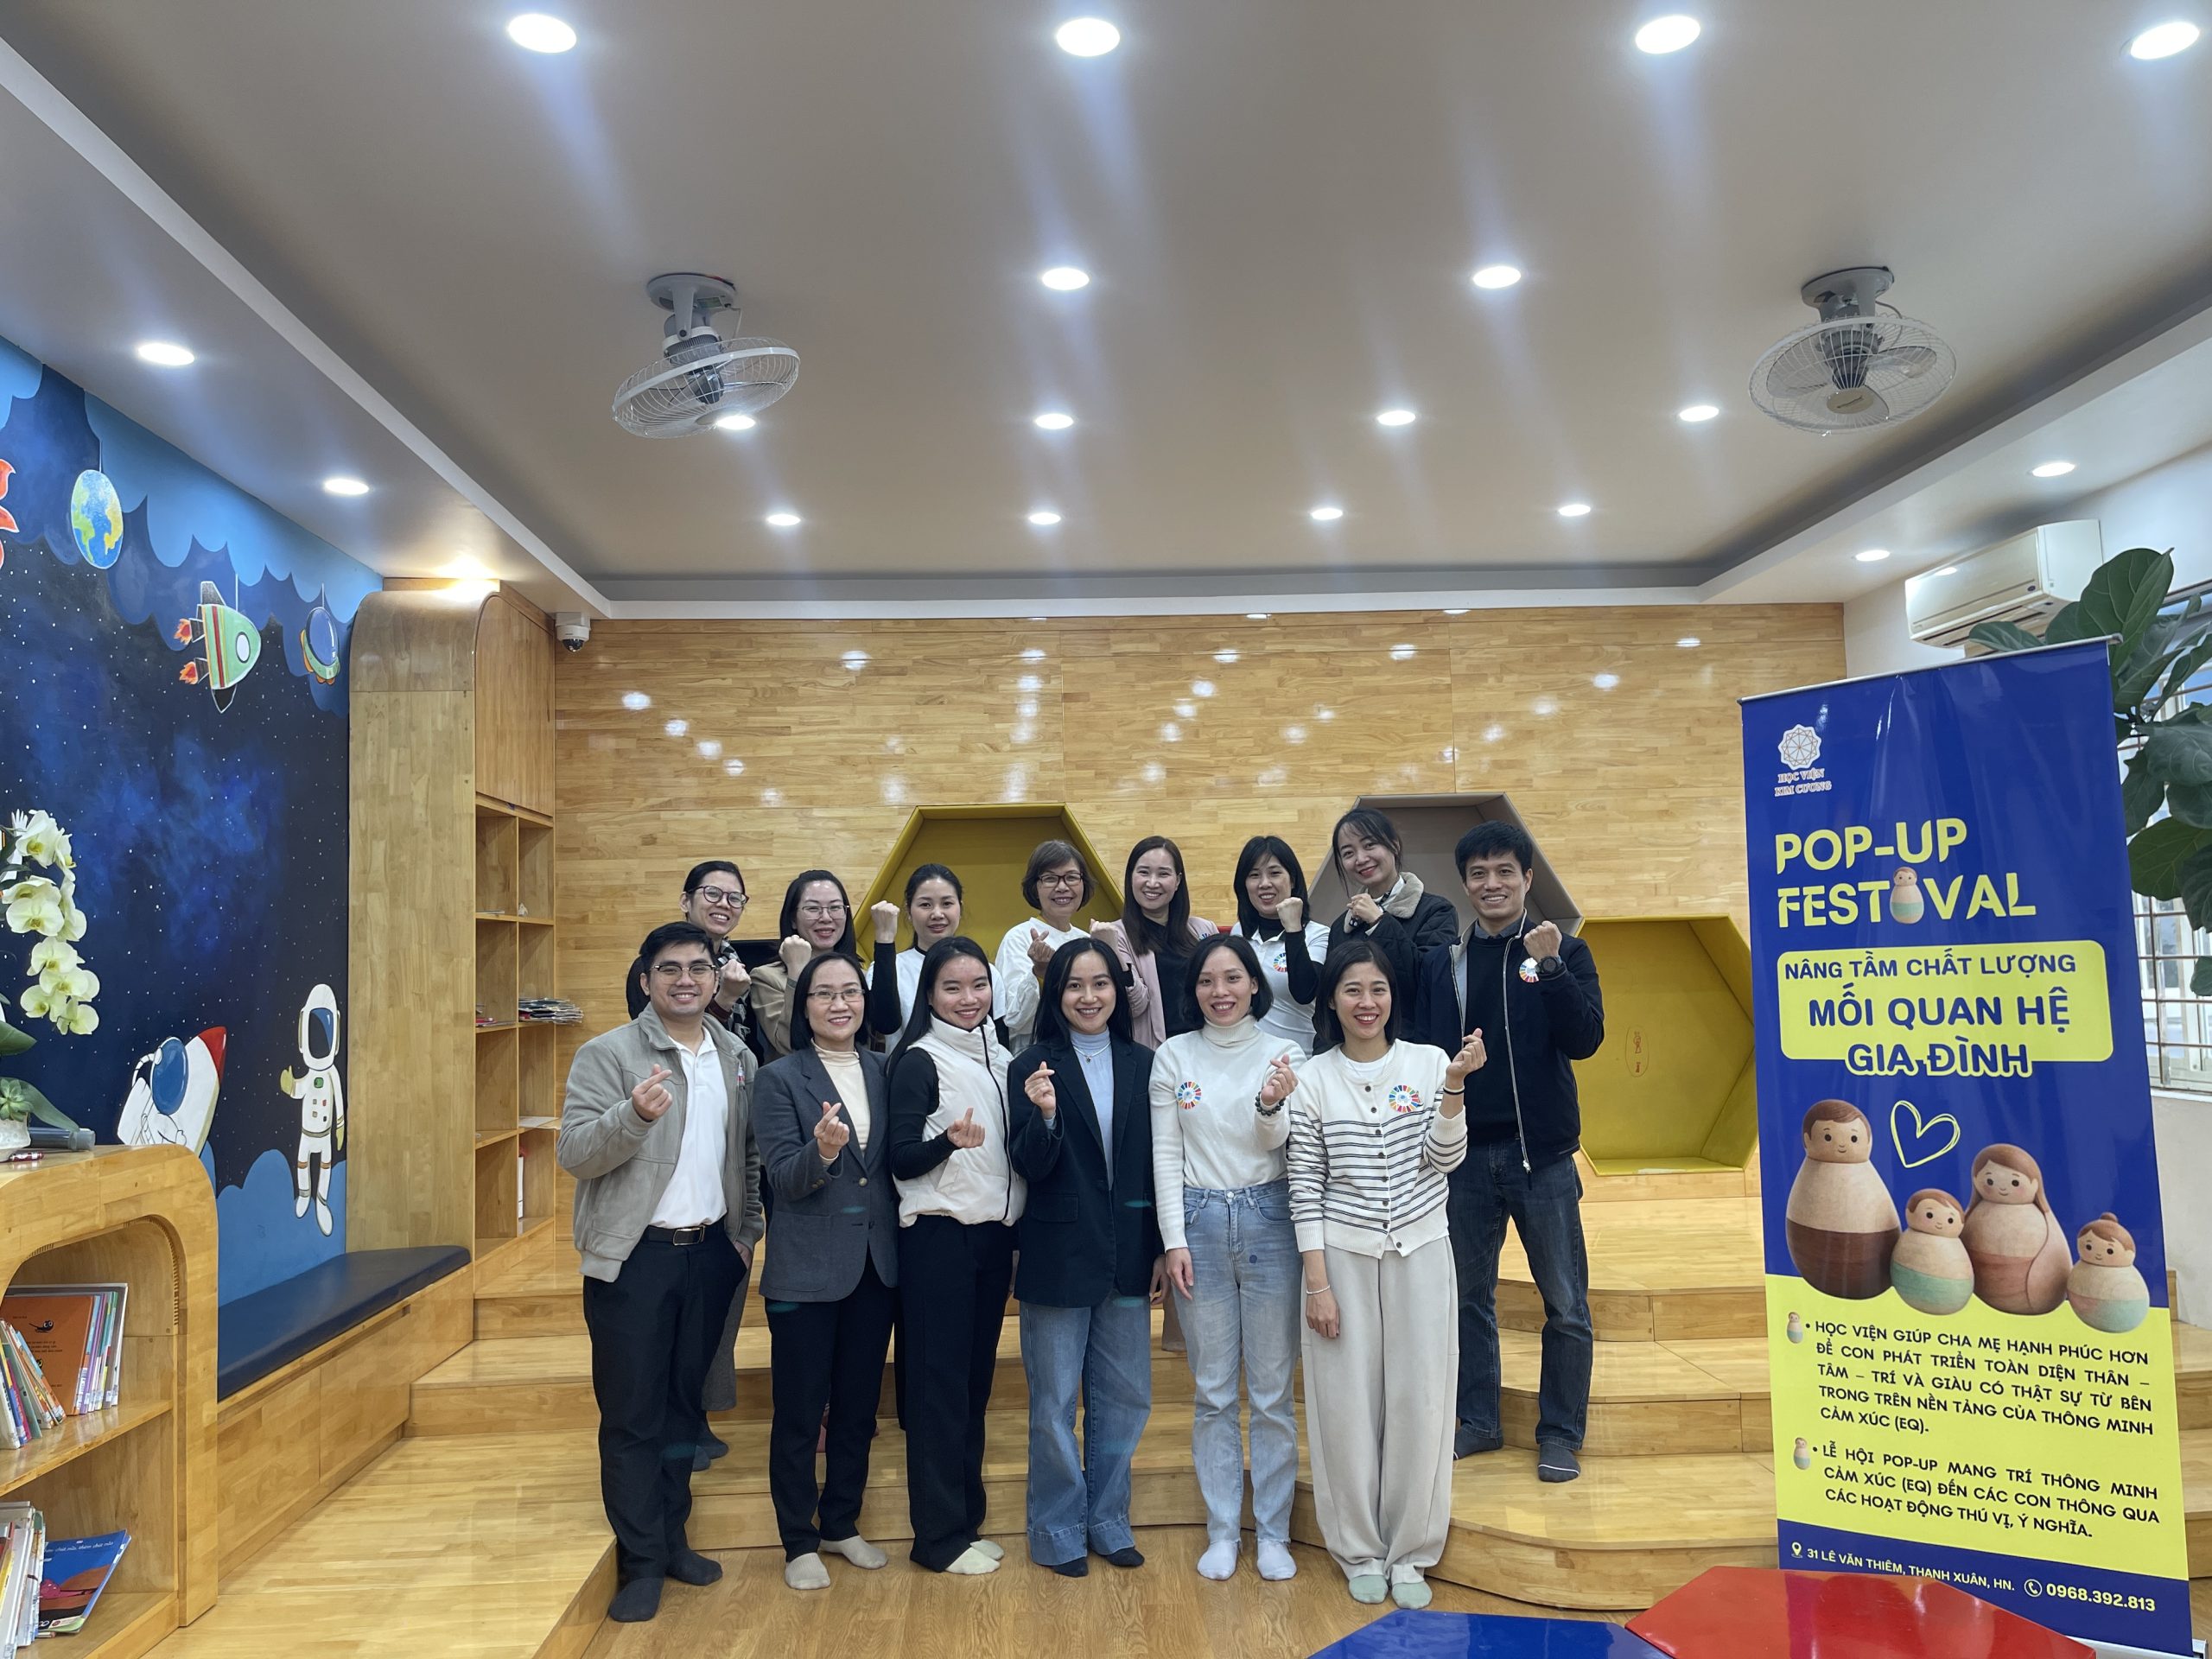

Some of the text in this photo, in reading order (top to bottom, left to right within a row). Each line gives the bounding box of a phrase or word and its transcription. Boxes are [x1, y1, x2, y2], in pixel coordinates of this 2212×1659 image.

[1776, 818, 1967, 874] POP-UP
[1778, 873, 2036, 927] FESTVAL
[1786, 949, 2075, 979] NÂNG TẦM CHẤT LƯỢNG
[1809, 982, 2069, 1033] MỐI QUAN HỆ
[1848, 1036, 2028, 1073] GIA ĐÌNH
[1816, 1321, 2147, 1364] HỌC VIỆN GIÚP CHA MẸ HẠNH PHÚC HƠN
[1817, 1338, 1832, 1355] ĐỂ
[1841, 1346, 1873, 1359] CON
[1884, 1351, 1921, 1364] PHÁT
[1931, 1351, 1974, 1370] TRIỂN
[1985, 1359, 2028, 1375] TOÀN
[2039, 1364, 2075, 1382] DIỆN
[2085, 1370, 2128, 1386] THÂN
[1818, 1363, 1848, 1378] TÂM
[1872, 1370, 1896, 1383] TRÍ
[1904, 1373, 1923, 1387] VÀ
[1932, 1376, 1971, 1391] GIÀU
[1980, 1381, 2004, 1395] CÓ
[2012, 1385, 2051, 1402] THẬT
[2061, 1391, 2082, 1406] SỰ
[2090, 1392, 2112, 1407] TỪ
[2121, 1395, 2151, 1411] BÊN
[1819, 1386, 2152, 1434] TRONG TRÊN NỀN TẢNG CỦA THÔNG MINH
[1821, 1408, 1929, 1433] CẢM XÚC (EQ).
[1823, 1441, 2157, 1499] LỄ HỘI POP-UP MANG TRÍ THÔNG MINH
[1825, 1466, 2159, 1522] CẢM XÚC (EQ) ĐẾN CÁC CON THÔNG QUA
[1826, 1489, 2092, 1536] CÁC HOẠT ĐỘNG THÚ VỊ, Ý NGHĨA.
[1808, 1548, 1818, 1559] 31
[1821, 1550, 1835, 1562] LÊ
[1839, 1554, 1862, 1567] VĂN
[1909, 1566, 1949, 1580] THANH
[1954, 1573, 1990, 1588] XUÂN,
[1994, 1579, 2014, 1590] HN.
[2047, 1584, 2155, 1611] 0968.392.813
